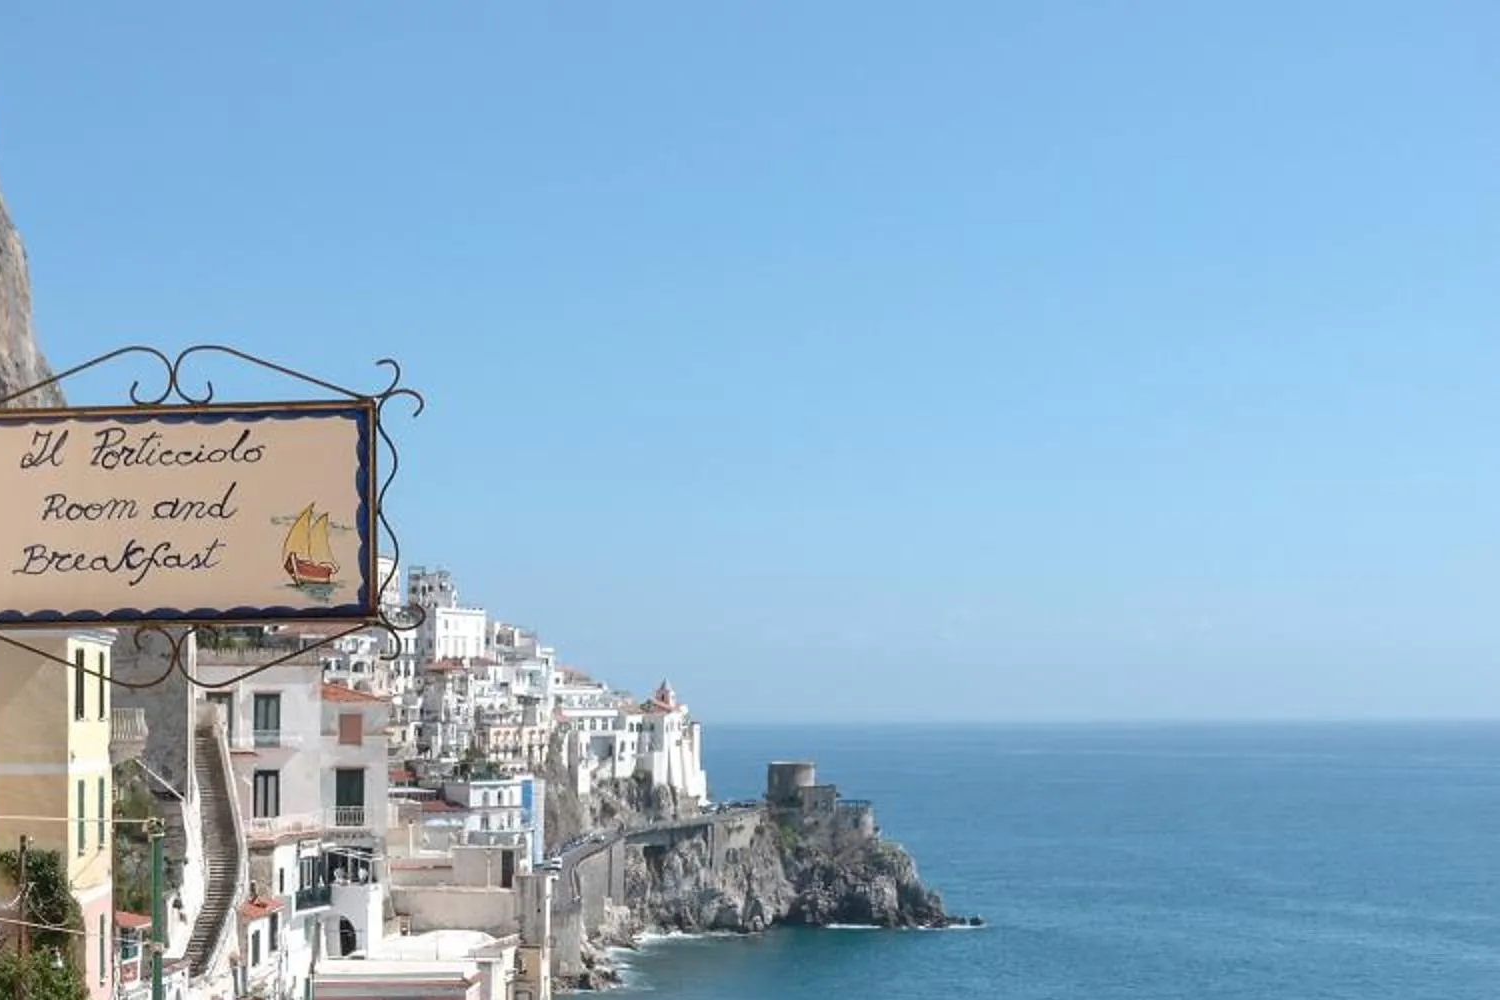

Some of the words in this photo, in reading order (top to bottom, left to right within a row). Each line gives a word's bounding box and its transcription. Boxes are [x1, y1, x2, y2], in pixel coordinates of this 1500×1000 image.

[20, 429, 69, 469] Il
[90, 427, 265, 469] Porticciolo
[41, 493, 138, 521] Room
[151, 481, 238, 520] and
[12, 539, 227, 586] Breakfast
